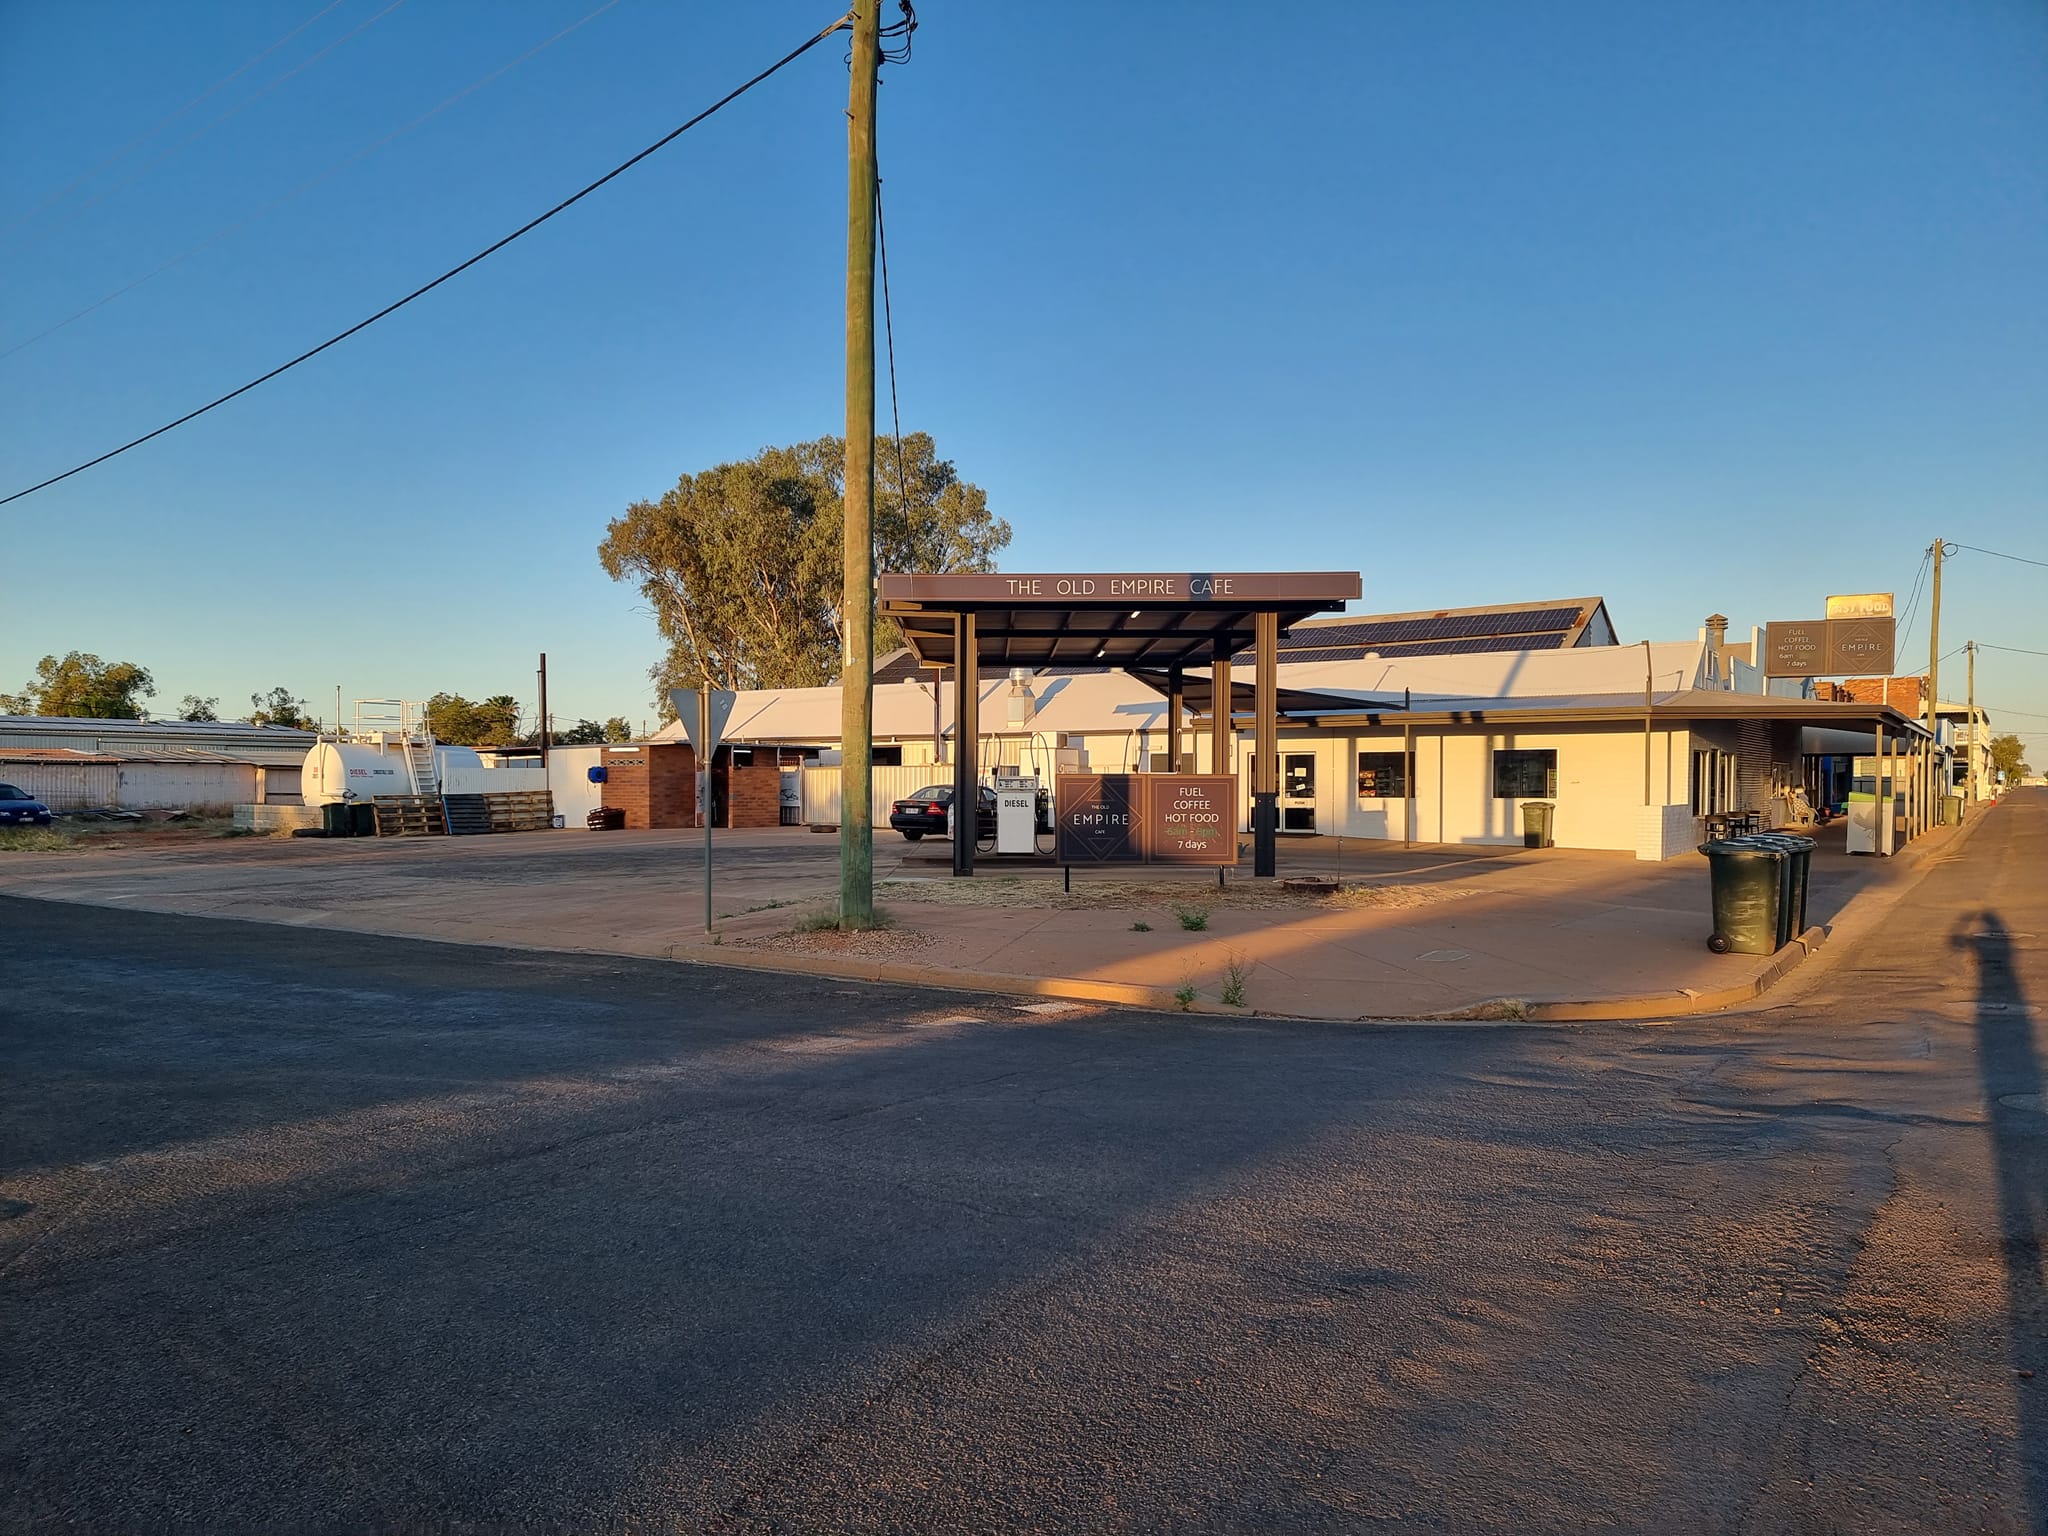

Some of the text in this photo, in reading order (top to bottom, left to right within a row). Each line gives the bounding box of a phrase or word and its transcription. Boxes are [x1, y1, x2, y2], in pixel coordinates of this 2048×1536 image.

[1006, 579, 1234, 595] THE OLD EMPIRE CAFE
[1841, 643, 1882, 652] EMPIRE
[1179, 787, 1205, 797] FUEL
[1004, 799, 1029, 808] DIESEL
[1173, 800, 1211, 810] COFFEE
[1073, 813, 1129, 825] EMPIRE
[1165, 813, 1219, 823] HOT FOOD
[1177, 839, 1207, 851] 7 days
